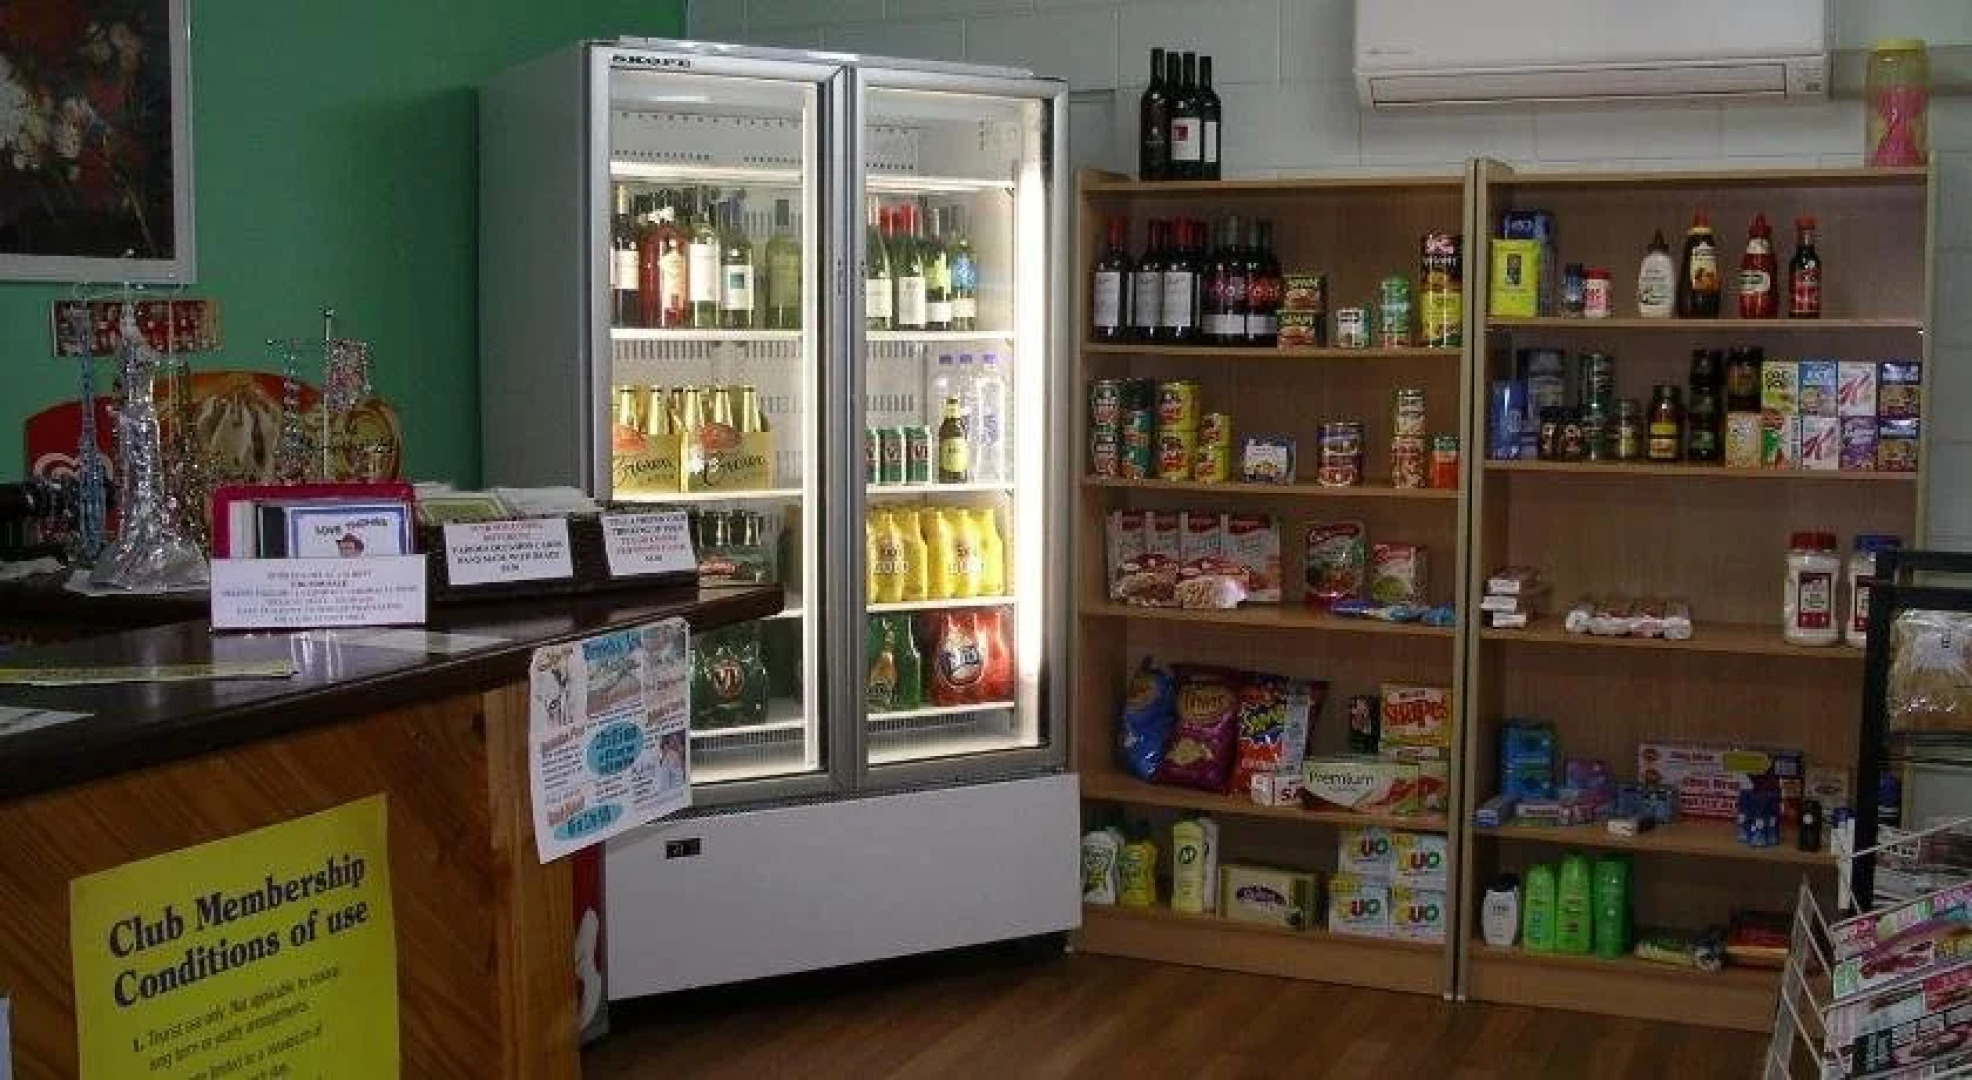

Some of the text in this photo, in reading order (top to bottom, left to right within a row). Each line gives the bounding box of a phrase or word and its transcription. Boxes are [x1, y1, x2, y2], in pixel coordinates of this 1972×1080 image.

[1307, 770, 1375, 788] Premium
[109, 852, 366, 958] Club Membership
[114, 931, 281, 1007] Conditions
[290, 907, 318, 946] of
[327, 900, 368, 934] use
